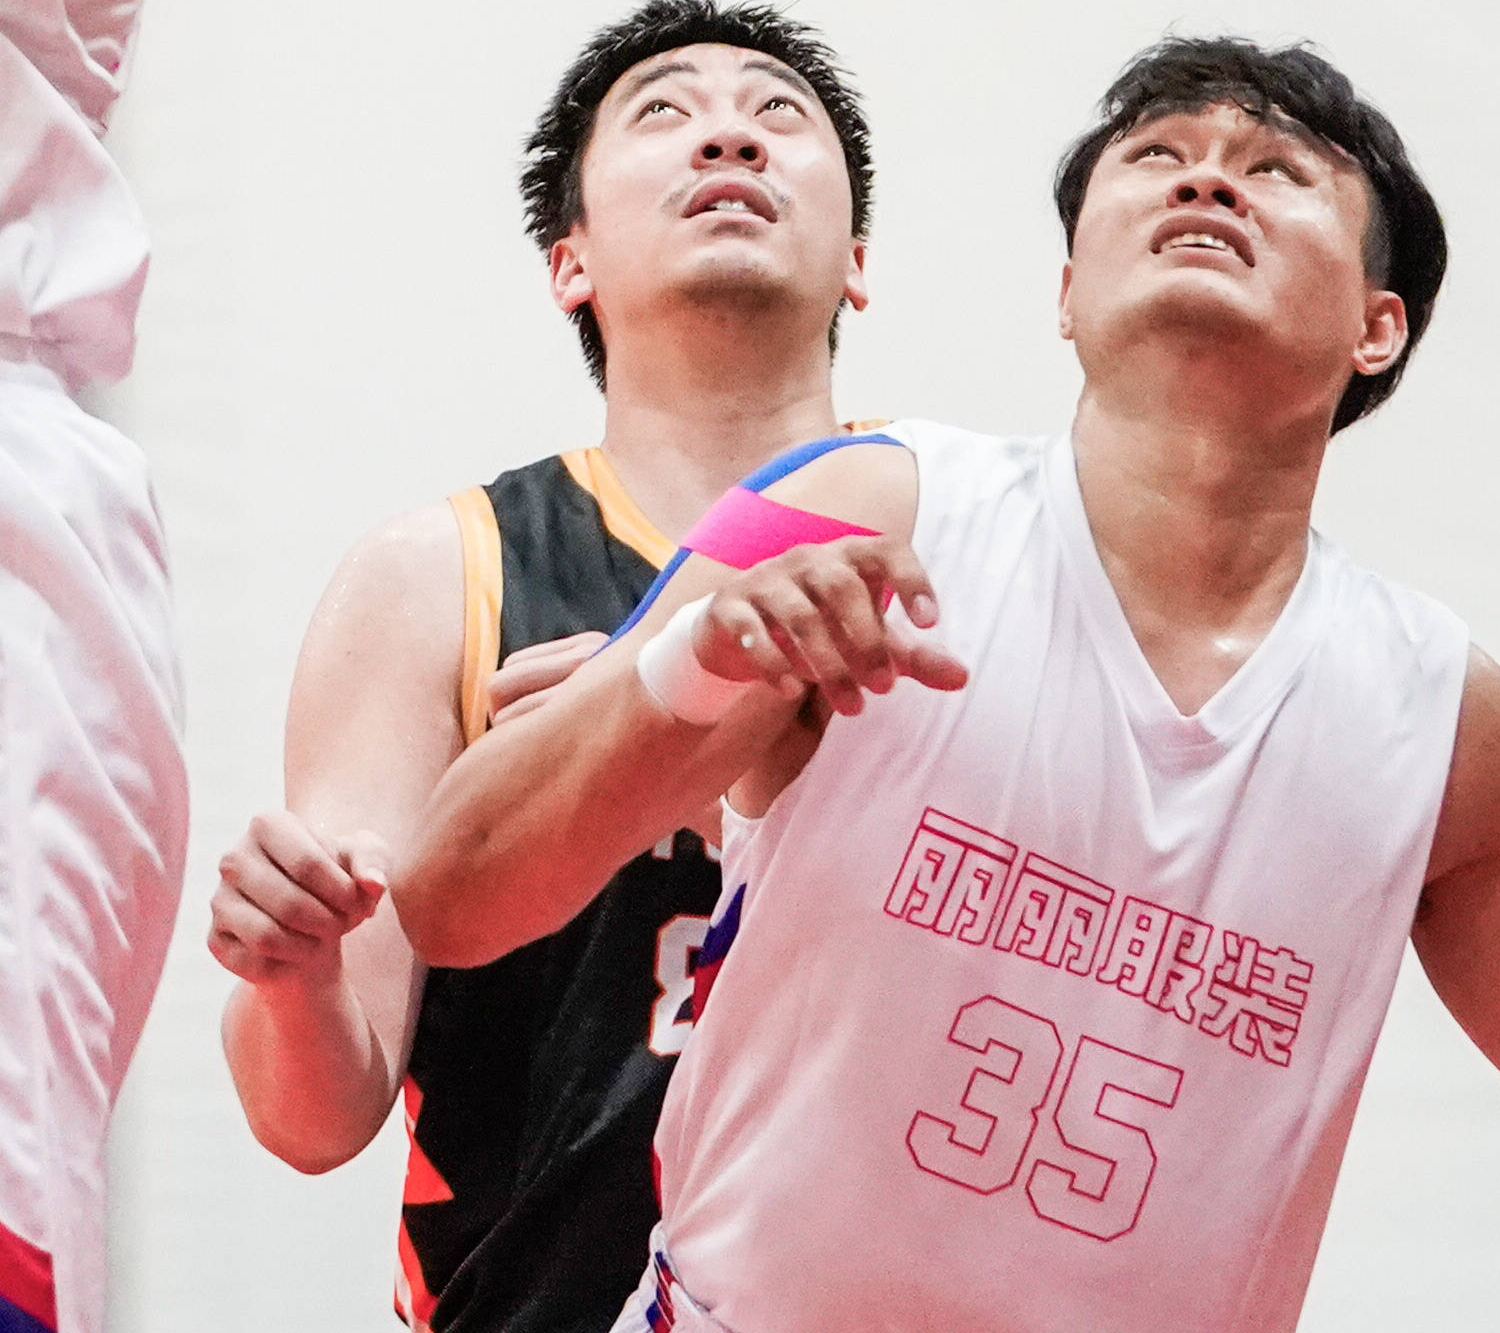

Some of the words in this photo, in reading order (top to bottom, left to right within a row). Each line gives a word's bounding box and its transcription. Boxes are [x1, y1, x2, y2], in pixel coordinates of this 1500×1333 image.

[883, 807, 1314, 1067] 丽丽服装
[904, 993, 1186, 1243] 35
